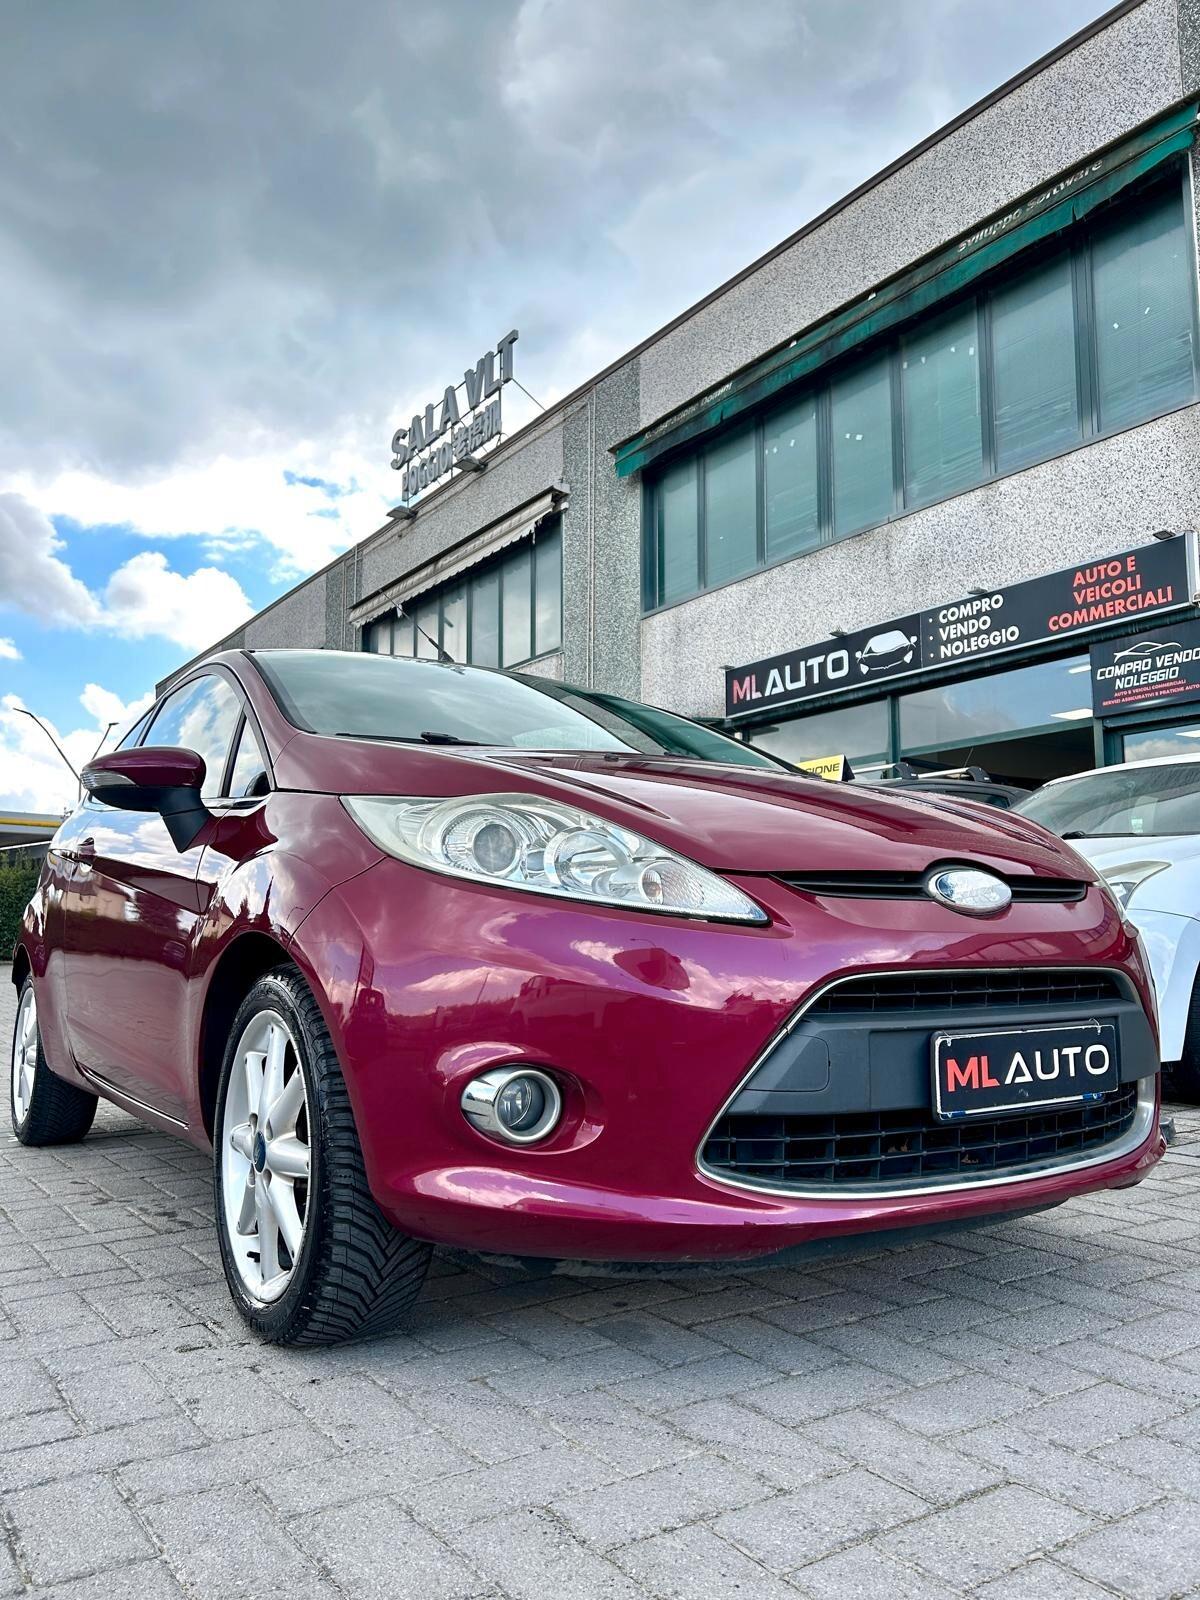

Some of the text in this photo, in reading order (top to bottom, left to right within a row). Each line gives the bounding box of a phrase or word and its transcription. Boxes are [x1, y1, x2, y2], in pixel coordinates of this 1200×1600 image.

[390, 329, 519, 470] SALA VLT
[401, 442, 453, 502] POGGIO
[1073, 555, 1136, 587] AUTO E
[1073, 574, 1141, 605] VEICOLI
[939, 594, 1003, 624] COMPRO
[1048, 586, 1173, 632] COMMERCIALI
[939, 615, 991, 641] VENDO
[940, 625, 1019, 659] NOLEGGIO
[732, 649, 849, 704] ML AUTO
[1096, 648, 1200, 680] COMPRO VENDO
[1114, 666, 1180, 690] NOLEGGIO
[1132, 686, 1151, 694] VEICOLI
[1151, 679, 1187, 691] COMMERCIALI
[945, 1044, 1110, 1093] ML AUTO
